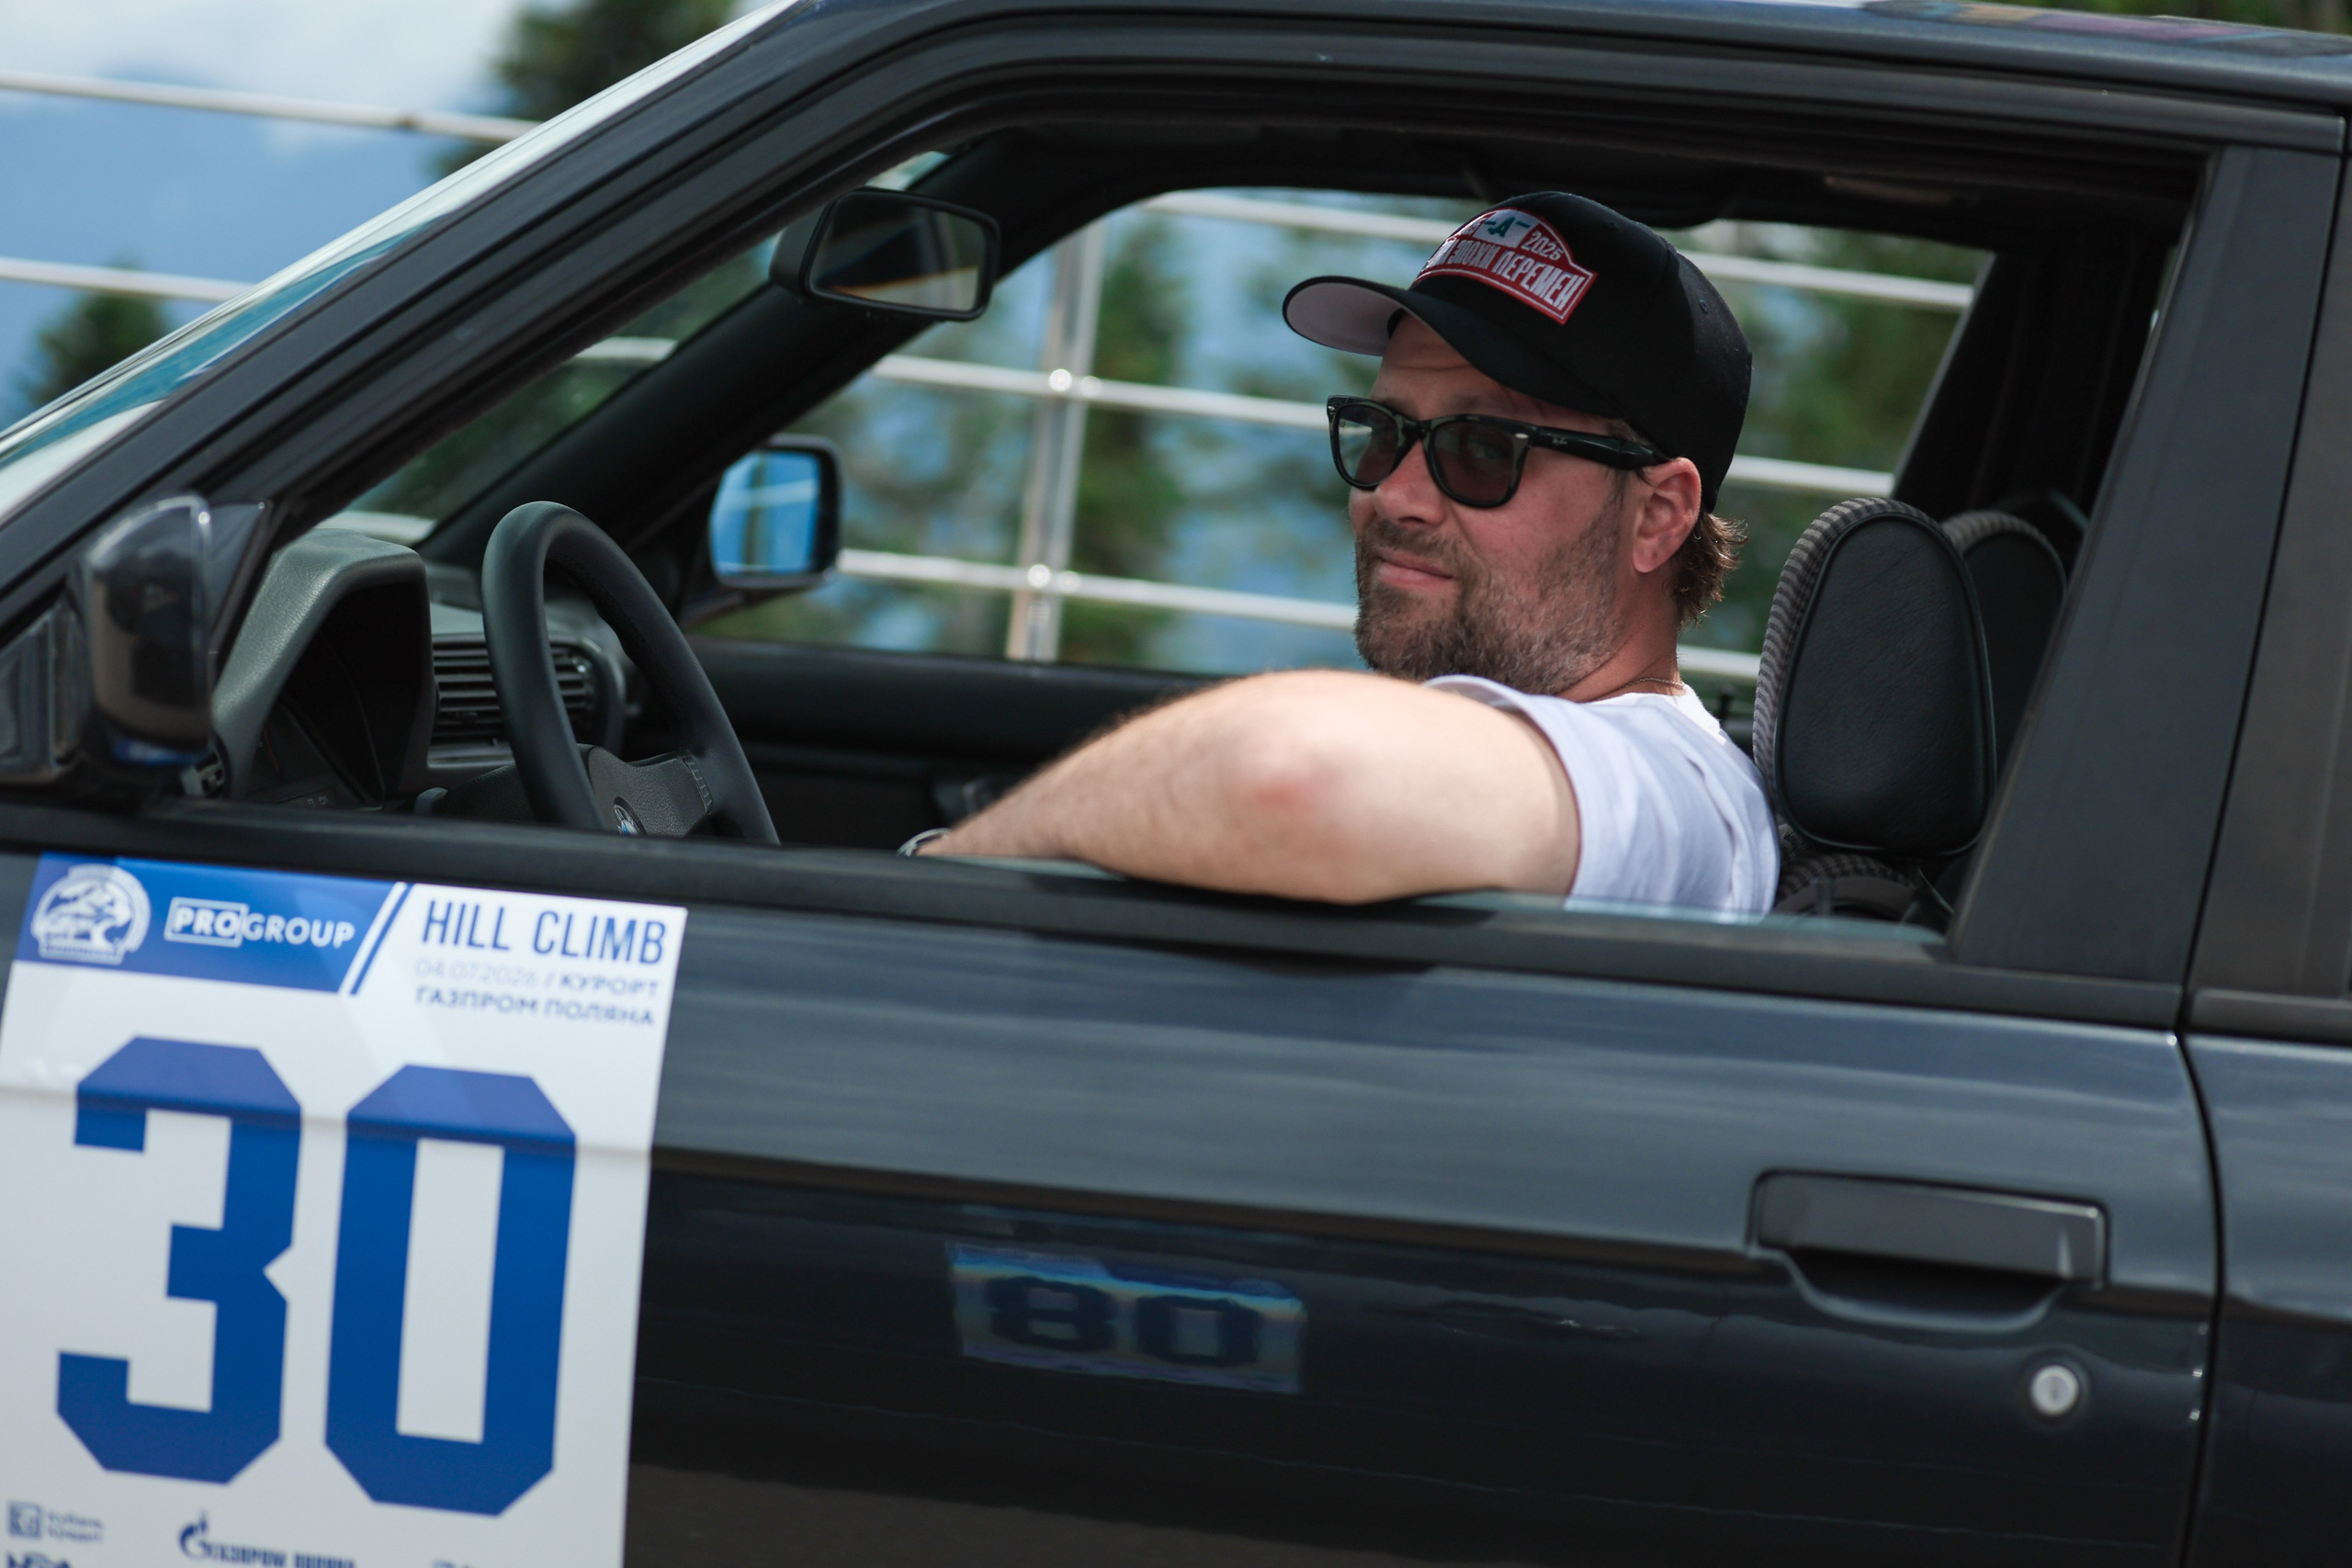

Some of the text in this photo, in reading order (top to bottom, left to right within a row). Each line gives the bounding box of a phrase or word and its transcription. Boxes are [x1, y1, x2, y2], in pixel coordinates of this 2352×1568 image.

[1521, 231, 1564, 261] 2025
[1491, 250, 1586, 311] ПЕРЕМЕН
[422, 899, 666, 964] HILL CLIMB
[415, 984, 654, 1025] ГАЗПРОМ ПОЛЯНА
[560, 973, 659, 998] КУРОРТ
[56, 1035, 577, 1517] 30
